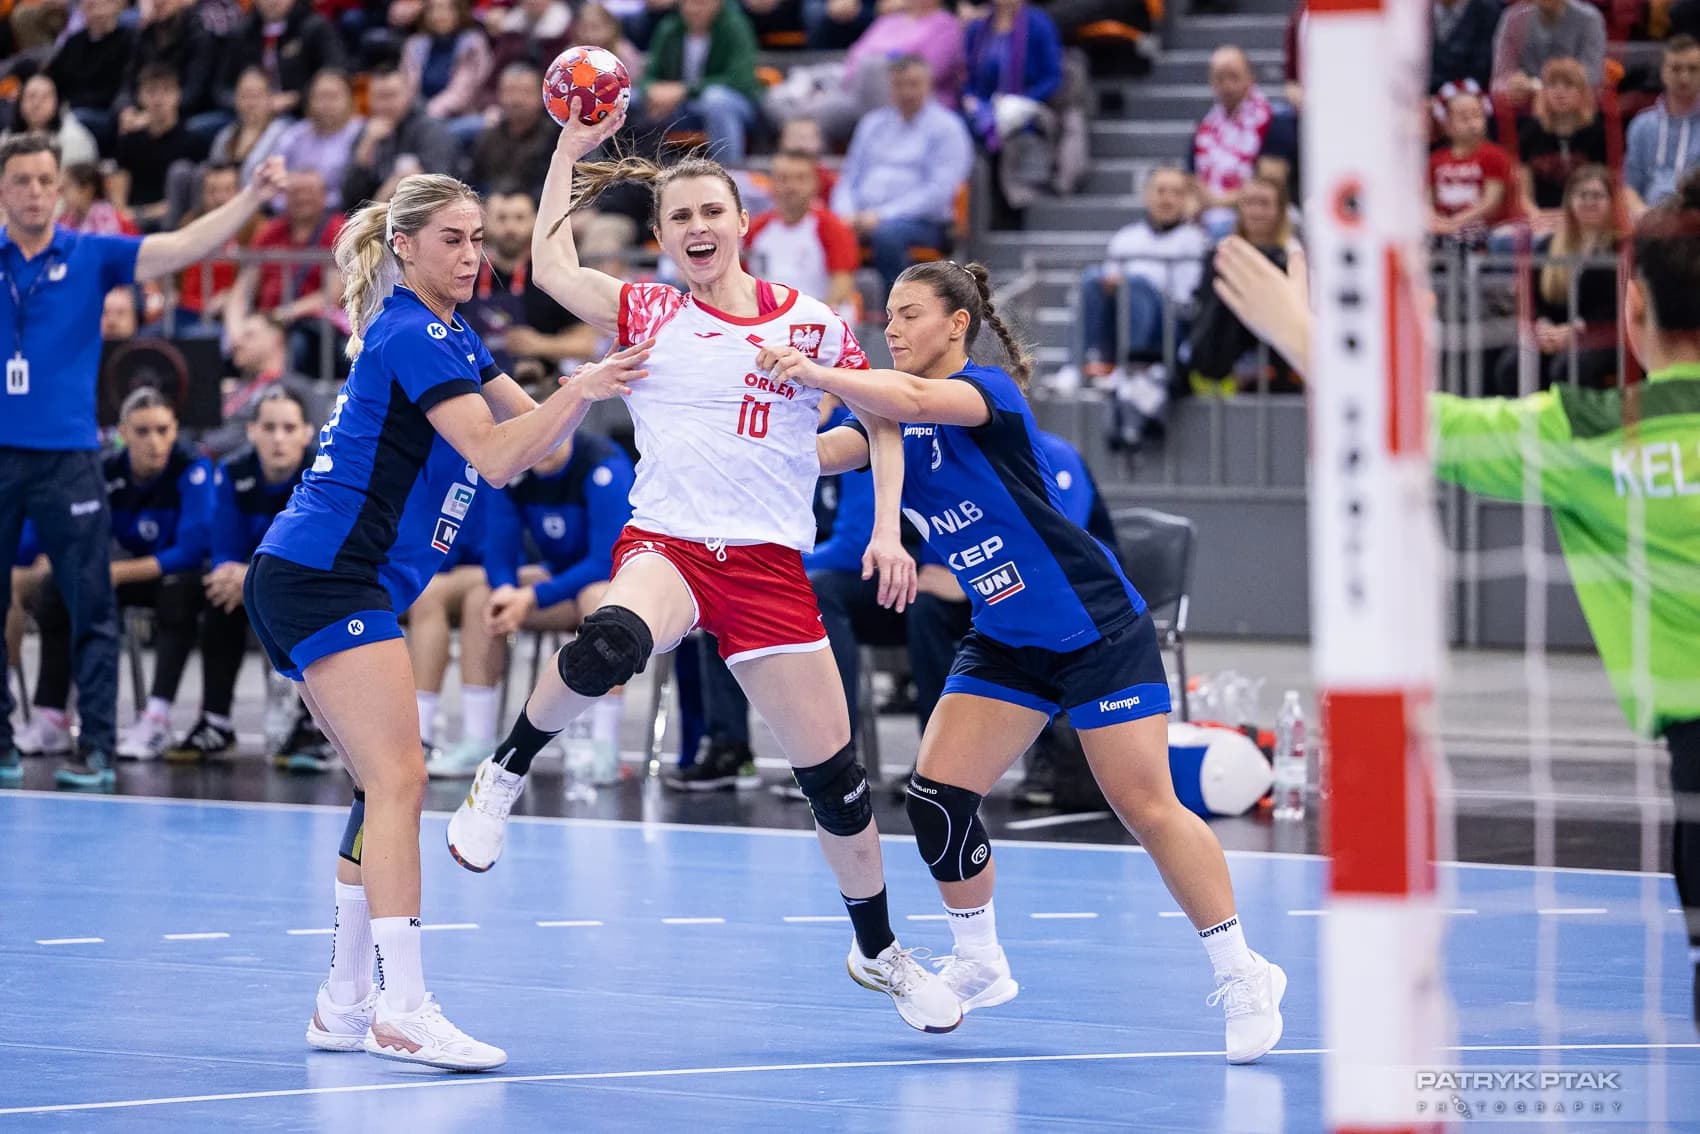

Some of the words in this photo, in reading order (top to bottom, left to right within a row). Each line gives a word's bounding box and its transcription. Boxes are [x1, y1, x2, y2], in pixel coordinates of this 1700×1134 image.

[744, 373, 797, 400] ORLEN
[1612, 441, 1700, 497] KEL
[930, 500, 984, 535] NLB
[1099, 696, 1140, 712] Kempa
